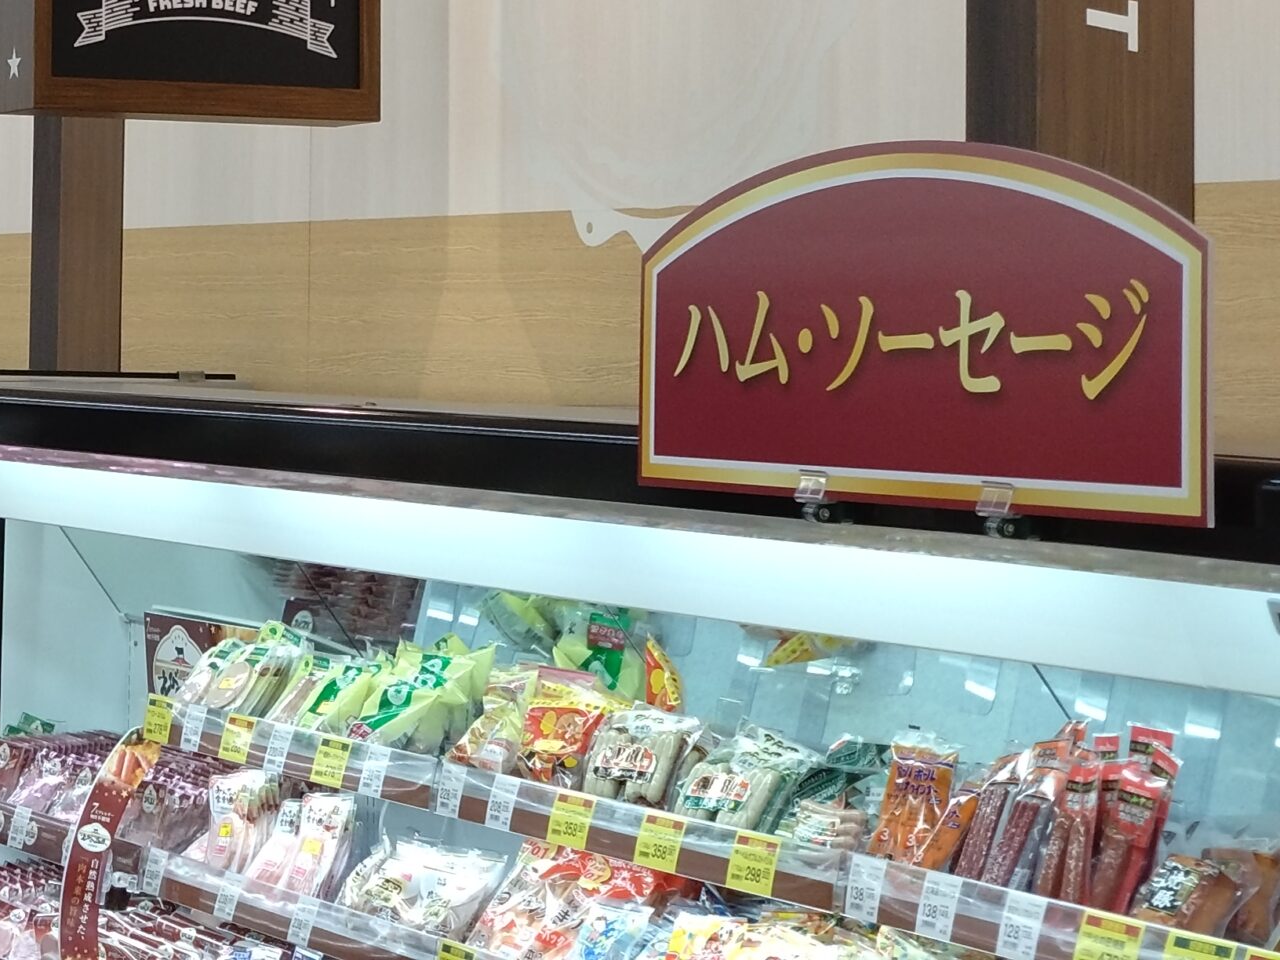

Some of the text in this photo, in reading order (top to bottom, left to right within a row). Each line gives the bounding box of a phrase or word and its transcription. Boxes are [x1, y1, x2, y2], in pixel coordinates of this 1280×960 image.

[672, 278, 1150, 402] ハム・ソーセージ
[563, 821, 578, 837] 358
[651, 843, 668, 860] 358
[744, 865, 762, 884] 298
[849, 885, 864, 902] 138
[922, 903, 938, 919] 138
[1003, 923, 1020, 939] 128
